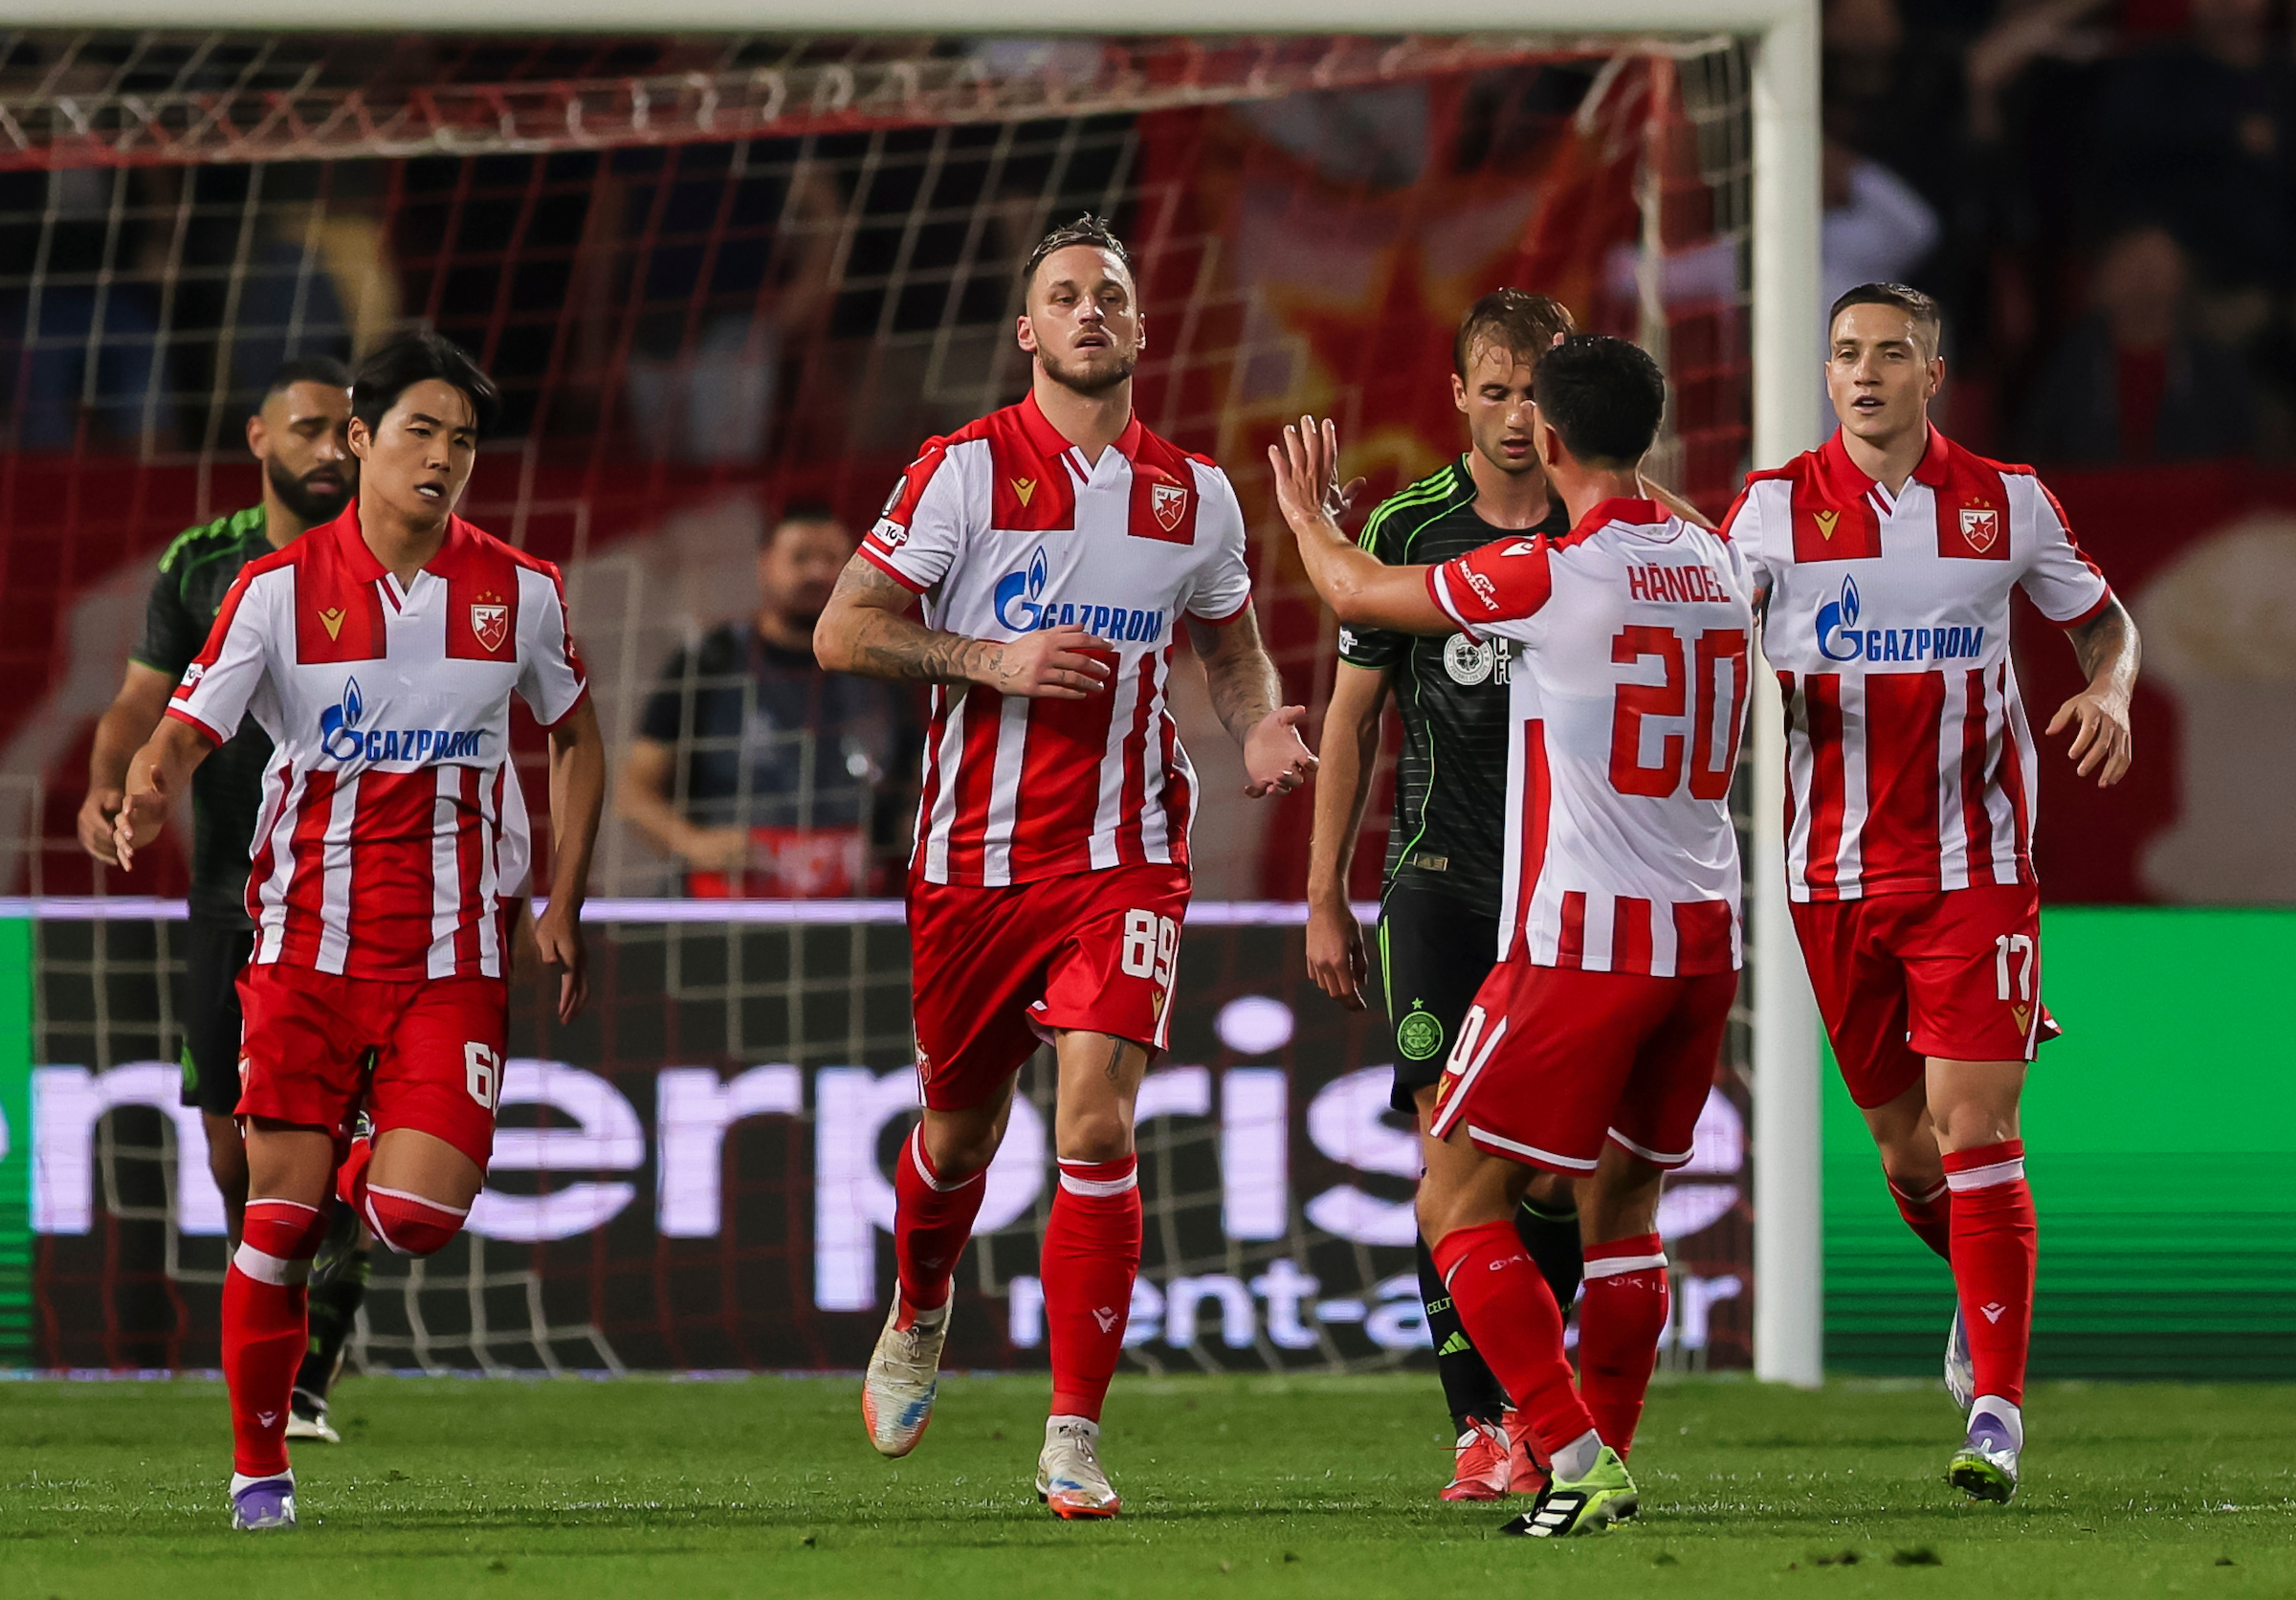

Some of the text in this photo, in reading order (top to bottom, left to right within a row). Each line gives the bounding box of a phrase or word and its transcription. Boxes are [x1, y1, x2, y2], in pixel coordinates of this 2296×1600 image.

[1626, 562, 1732, 603] HÄNDEL
[1040, 602, 1164, 643] GAZPROM
[1866, 626, 1985, 661] GAZPROM
[1608, 625, 1749, 800] 20
[364, 728, 486, 762] GAZPROM
[1121, 908, 1176, 989] 89
[1996, 933, 2033, 1002] 17
